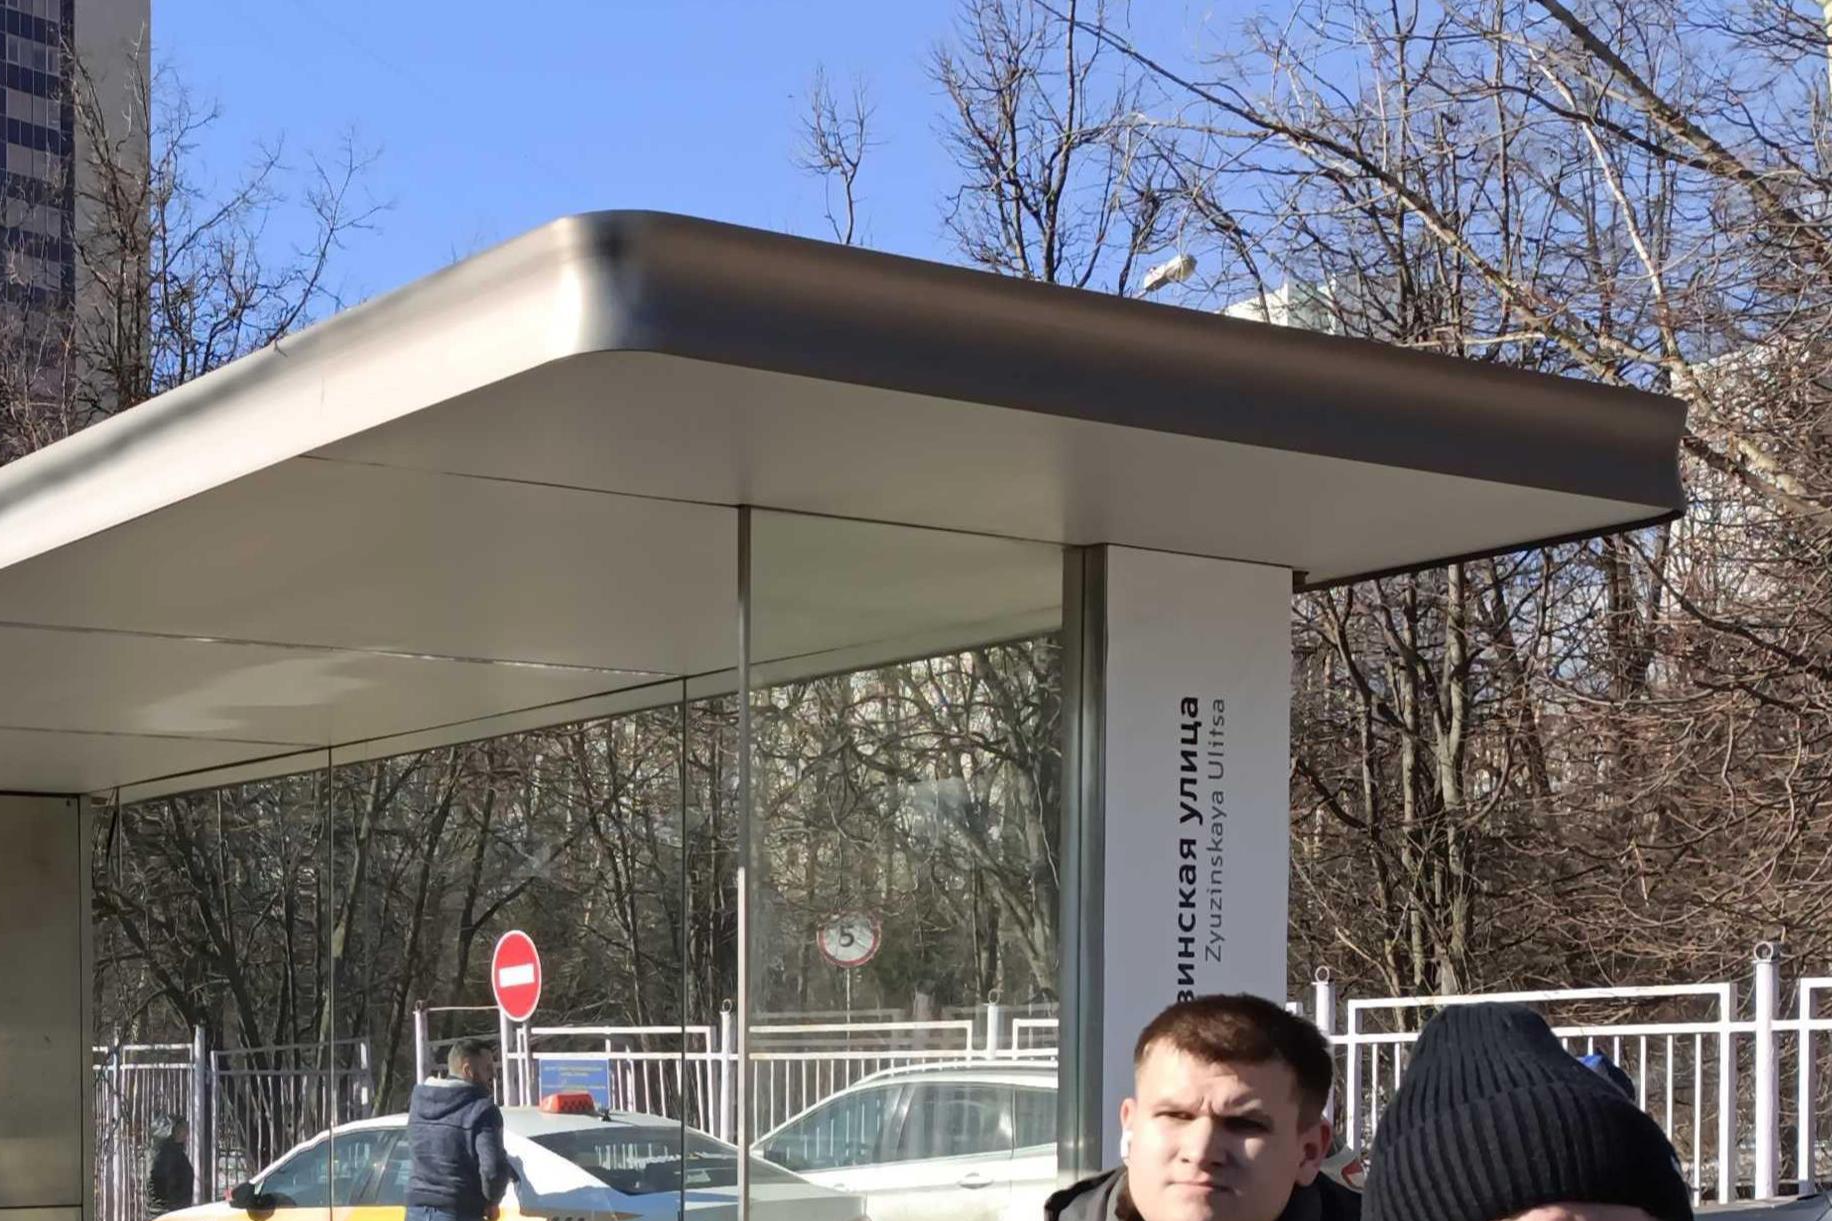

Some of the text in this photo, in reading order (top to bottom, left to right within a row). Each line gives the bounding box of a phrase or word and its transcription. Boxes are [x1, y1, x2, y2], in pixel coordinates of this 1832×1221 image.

[1179, 696, 1203, 826] улица
[1205, 698, 1227, 962] Zyuzinskaya Ulitsa
[839, 924, 855, 948] 5
